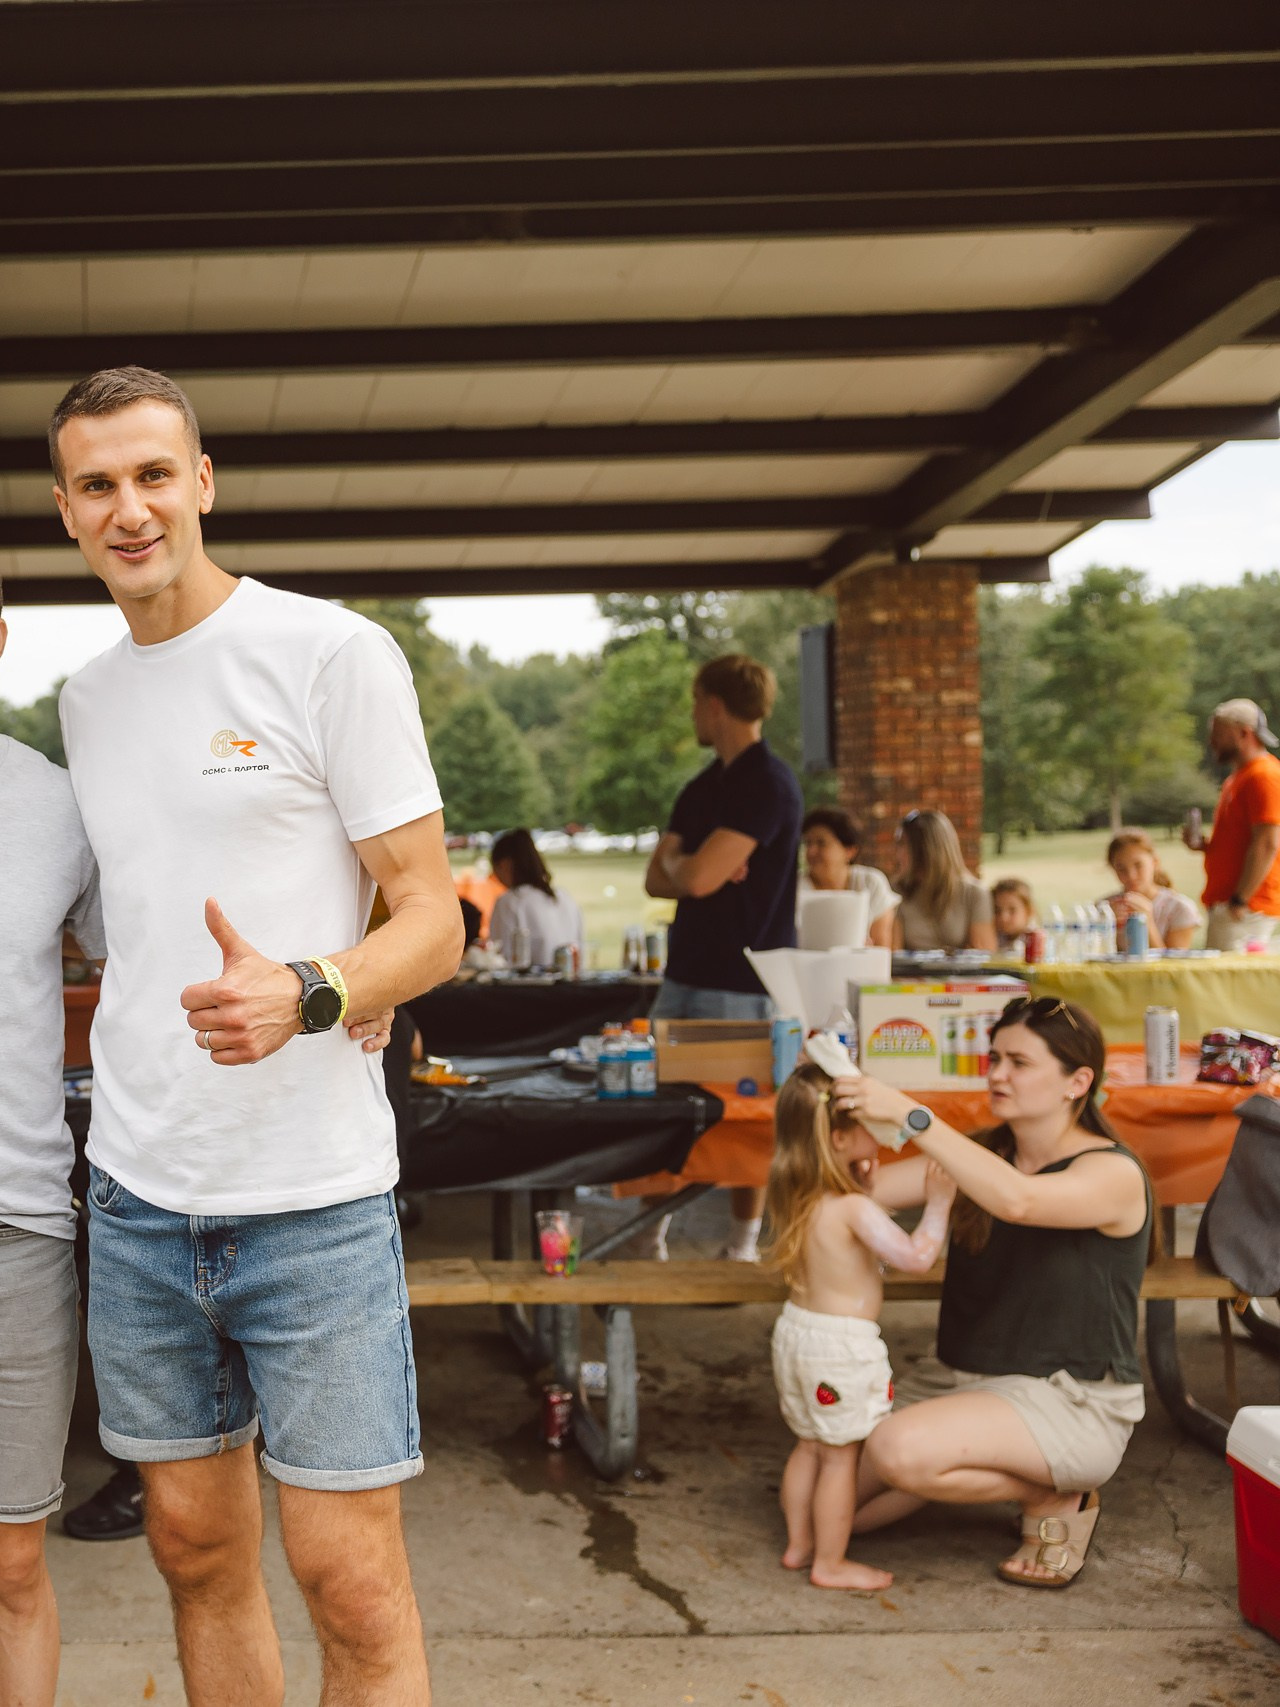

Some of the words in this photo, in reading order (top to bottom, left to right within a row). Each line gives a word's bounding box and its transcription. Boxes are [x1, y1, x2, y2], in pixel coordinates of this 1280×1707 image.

[202, 767, 227, 776] OCMC
[234, 764, 270, 773] RAPTOR
[330, 971, 342, 989] STOP
[880, 1024, 923, 1038] HARD
[873, 1037, 931, 1053] SELTZER
